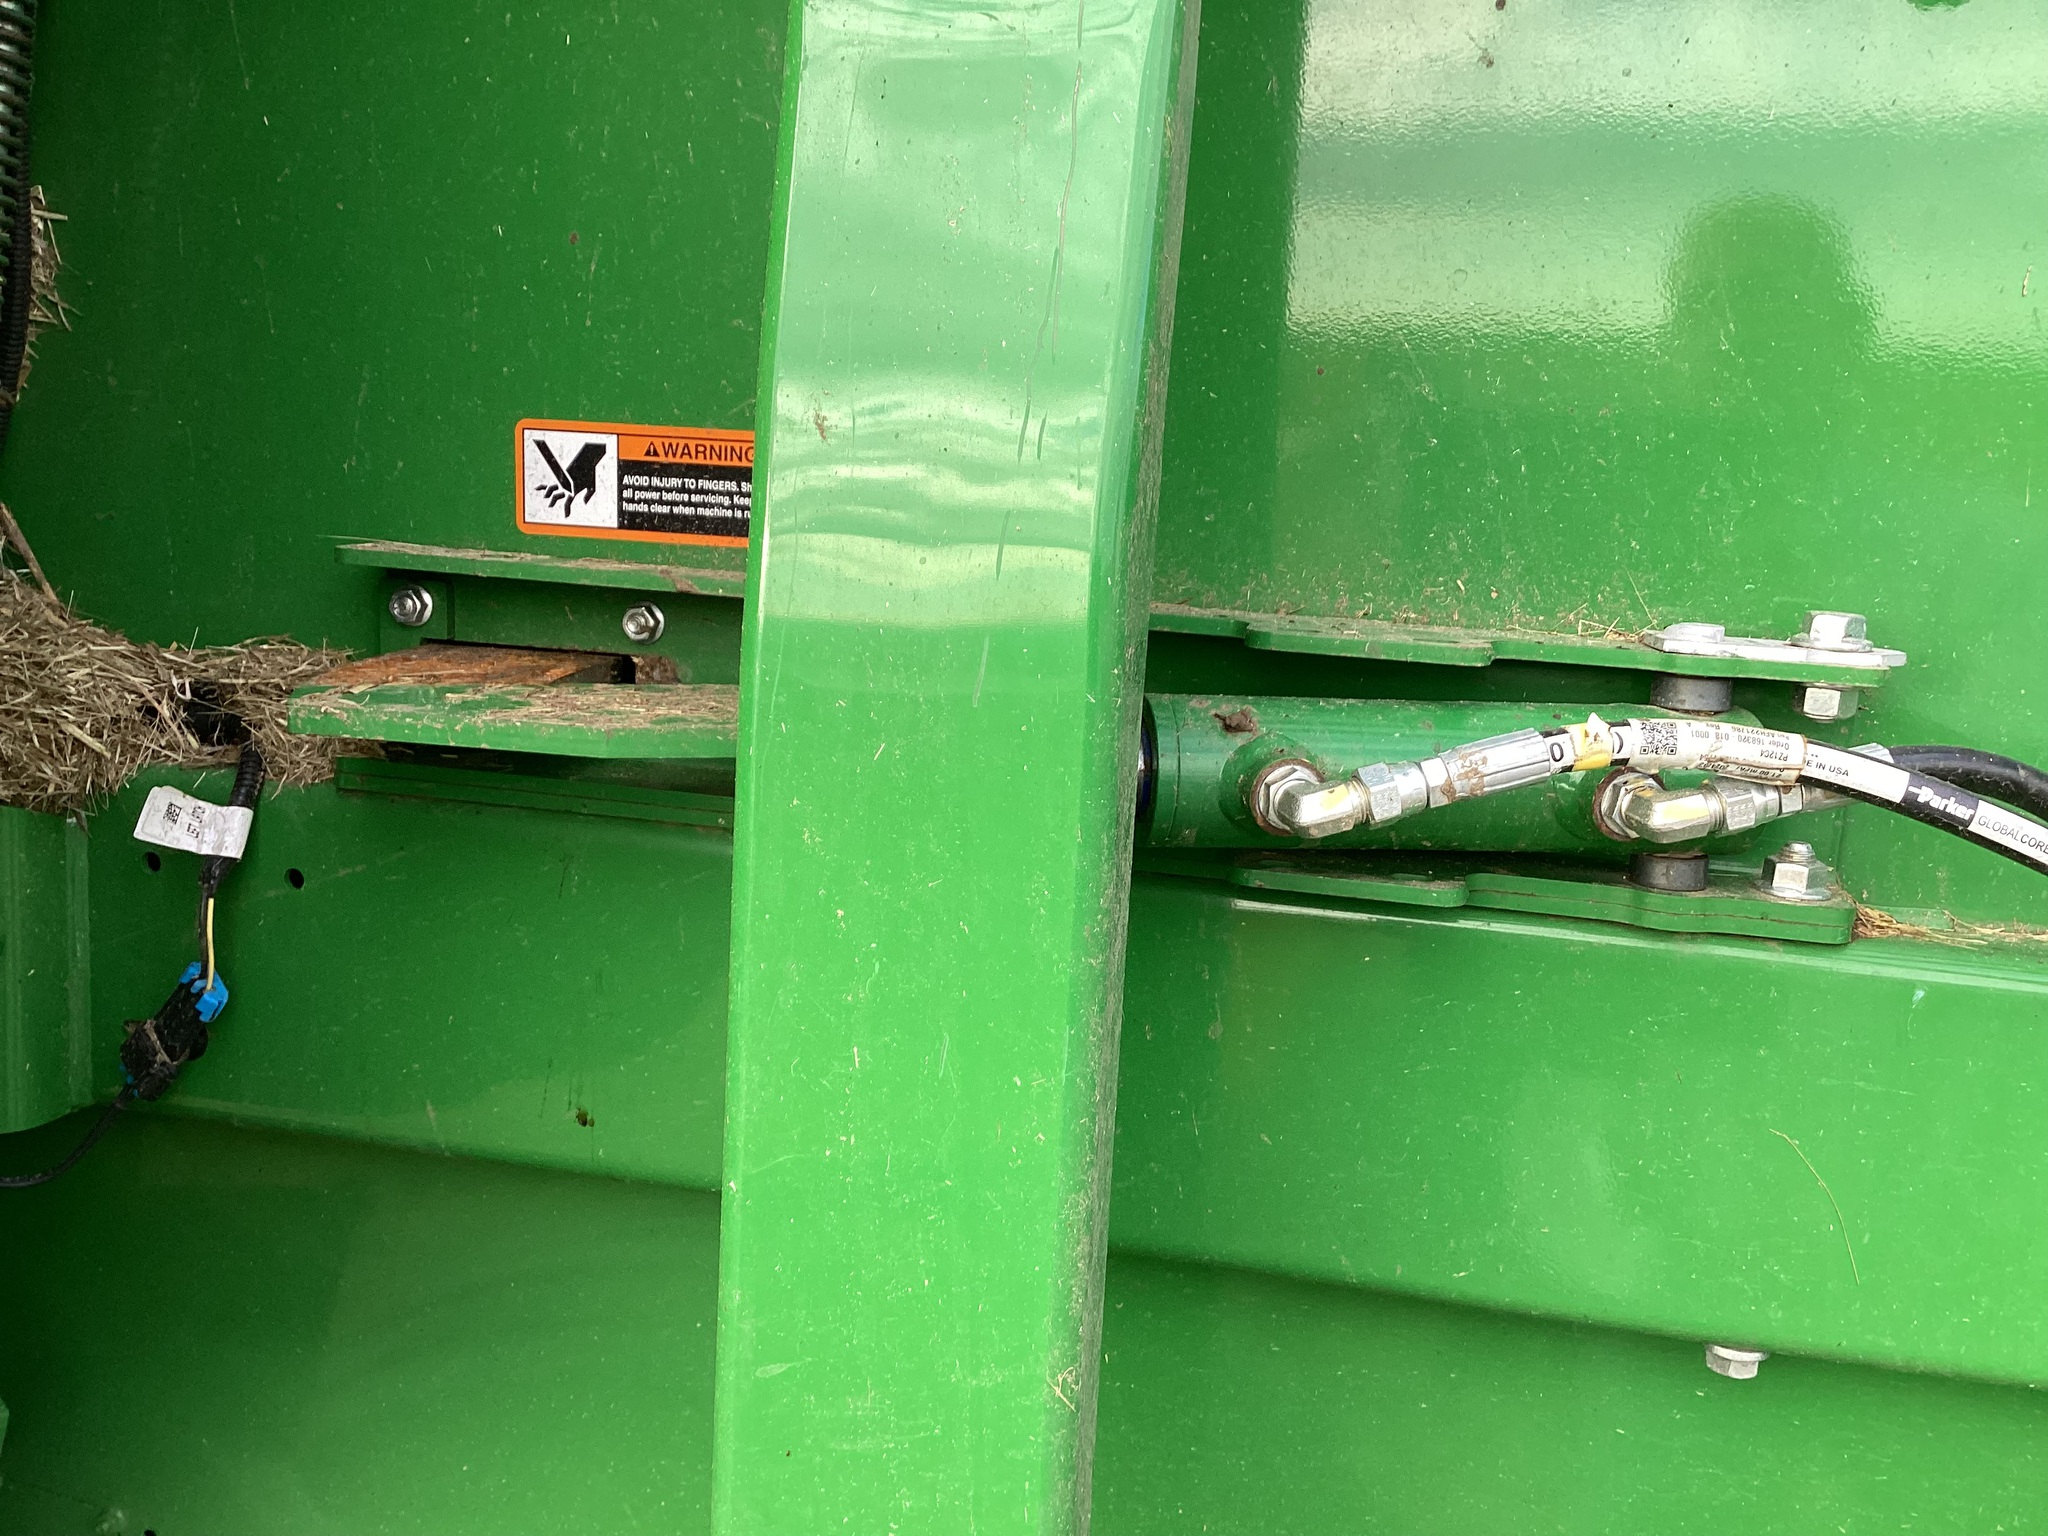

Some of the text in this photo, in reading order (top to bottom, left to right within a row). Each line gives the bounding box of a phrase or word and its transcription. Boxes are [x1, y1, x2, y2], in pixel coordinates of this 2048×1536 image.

[622, 474, 752, 493] AVOID INJURY TO FINGERS. Sh
[622, 489, 634, 499] all
[634, 491, 661, 502] power
[662, 491, 690, 502] before
[690, 493, 732, 505] servicing.
[622, 502, 649, 512] hands
[649, 504, 671, 513] clear
[672, 505, 696, 515] when
[696, 506, 733, 517] machine
[734, 508, 743, 518] is
[1768, 739, 1790, 751] Order
[1815, 762, 1826, 771] IN
[1828, 765, 1849, 776] USA
[1917, 785, 1976, 821] Parker
